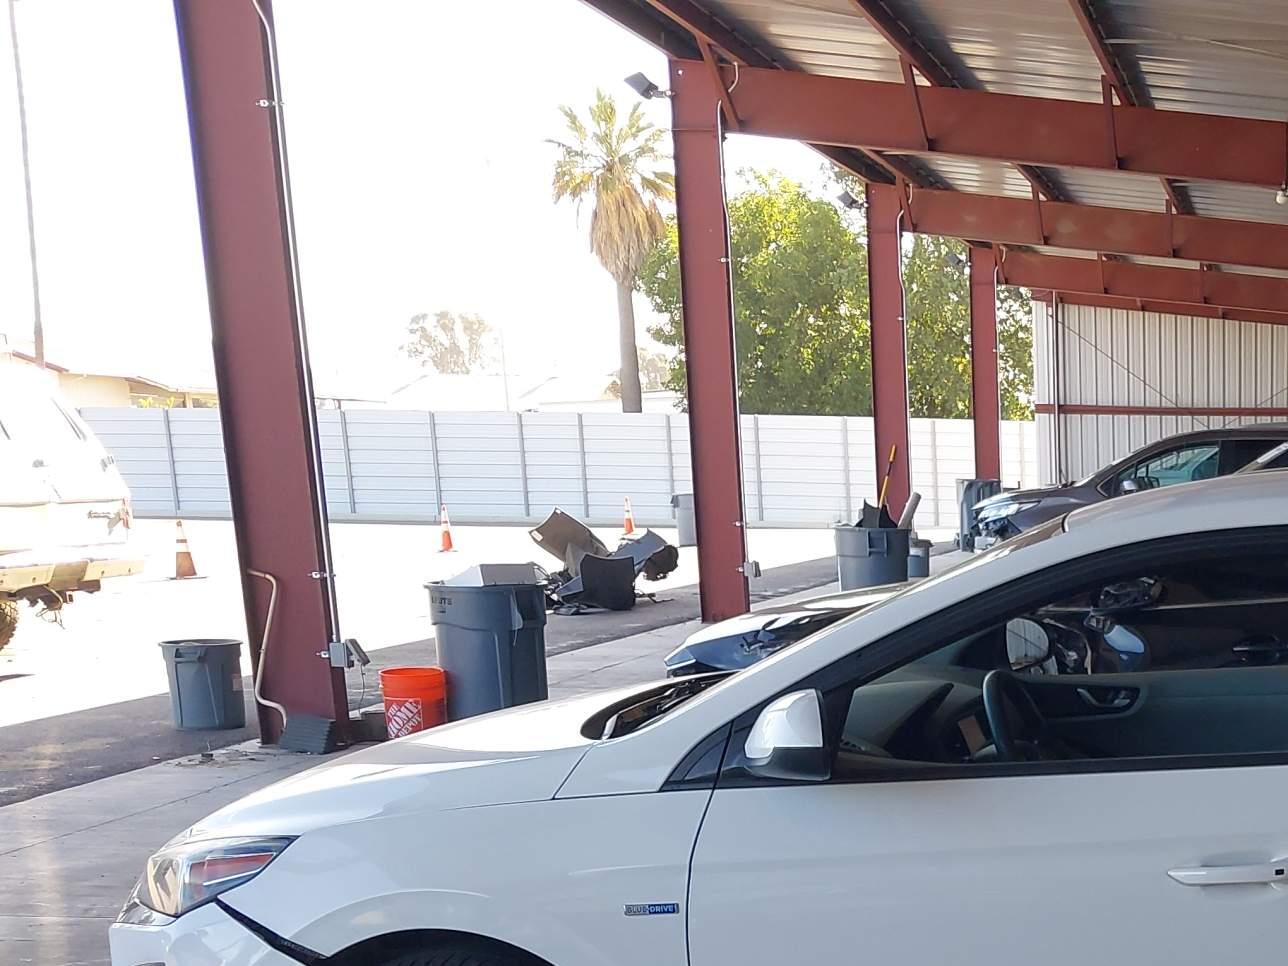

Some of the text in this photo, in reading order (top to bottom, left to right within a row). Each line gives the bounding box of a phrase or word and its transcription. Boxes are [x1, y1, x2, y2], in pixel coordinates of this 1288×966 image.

[388, 703, 400, 718] THE
[388, 701, 421, 738] HOME
[398, 714, 421, 736] DEPOT
